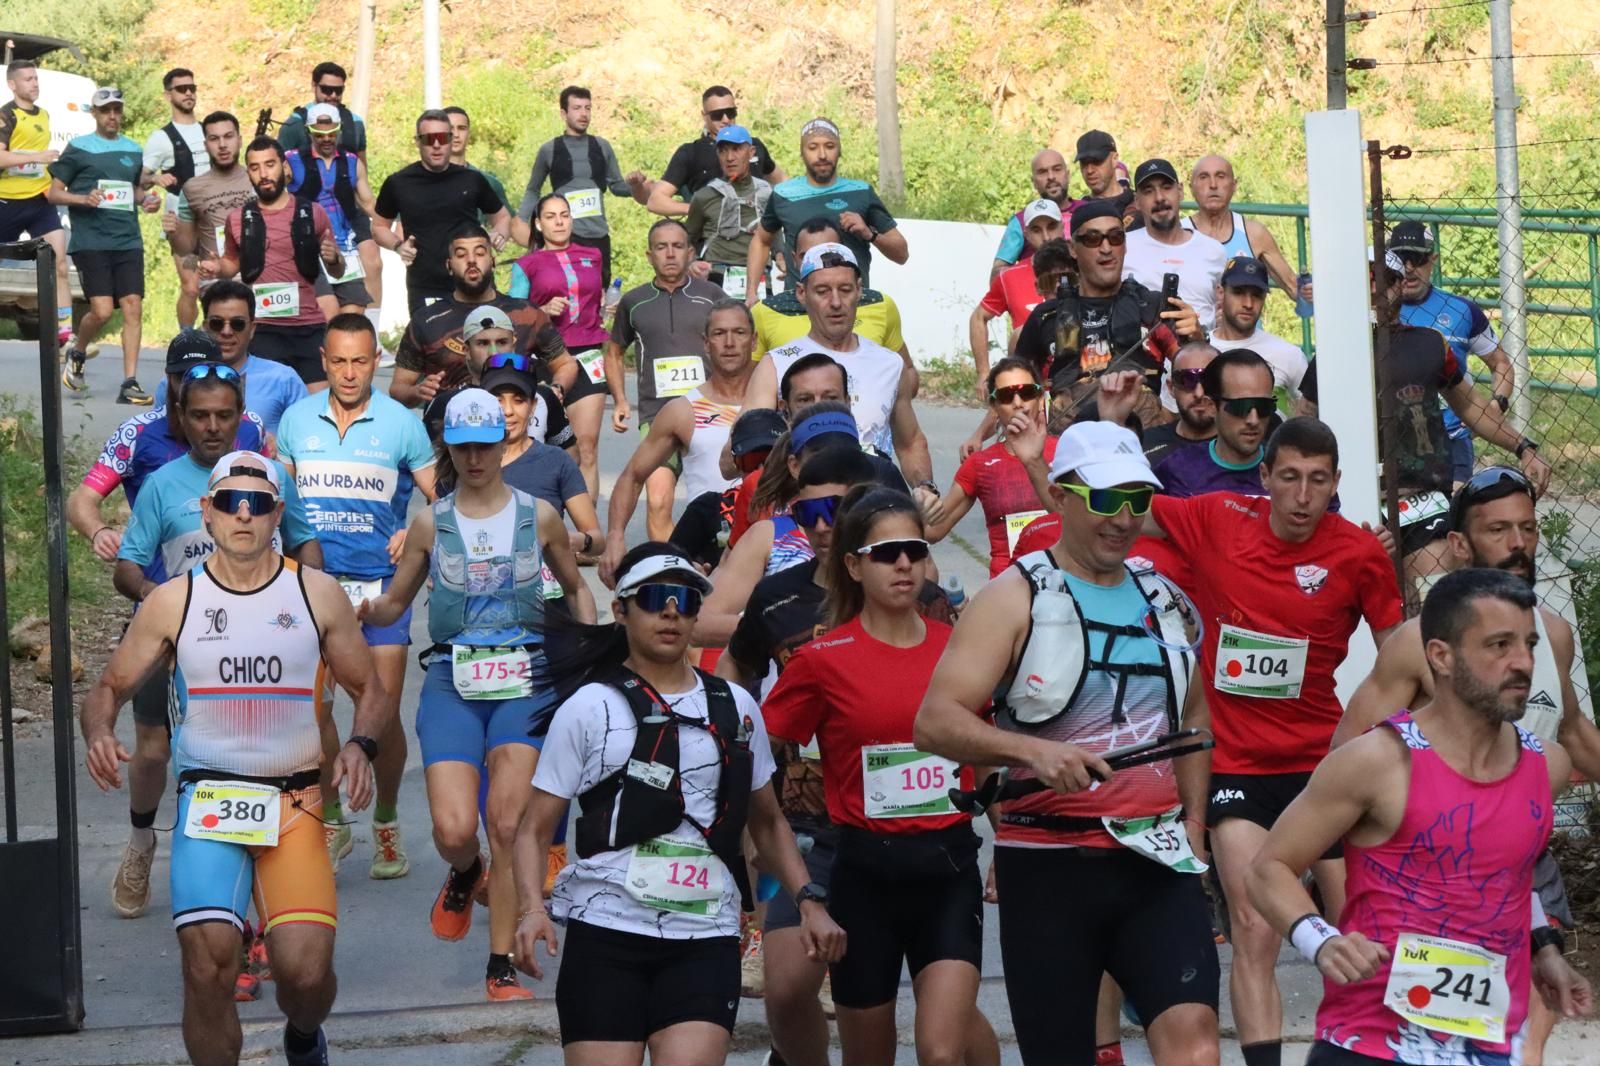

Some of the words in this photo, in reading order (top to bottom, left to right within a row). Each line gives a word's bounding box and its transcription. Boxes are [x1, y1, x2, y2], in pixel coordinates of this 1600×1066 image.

[115, 190, 127, 200] 27
[579, 196, 596, 208] 347
[269, 294, 291, 305] 109
[671, 367, 699, 381] 211
[298, 473, 320, 488] SAN
[324, 474, 385, 492] URBANO
[325, 523, 374, 533] INTERSPORT
[184, 541, 214, 560] SAN
[1222, 635, 1239, 647] 21K
[456, 653, 473, 661] 21K
[219, 655, 283, 684] CHICO
[472, 660, 528, 680] 175-2
[1244, 653, 1289, 678] 104
[868, 756, 889, 766] 21K
[901, 765, 945, 791] 105
[196, 790, 215, 800] 10K
[218, 800, 266, 823] 380
[637, 842, 660, 855] 21K
[666, 862, 709, 890] 124
[1430, 966, 1492, 1007] 241
